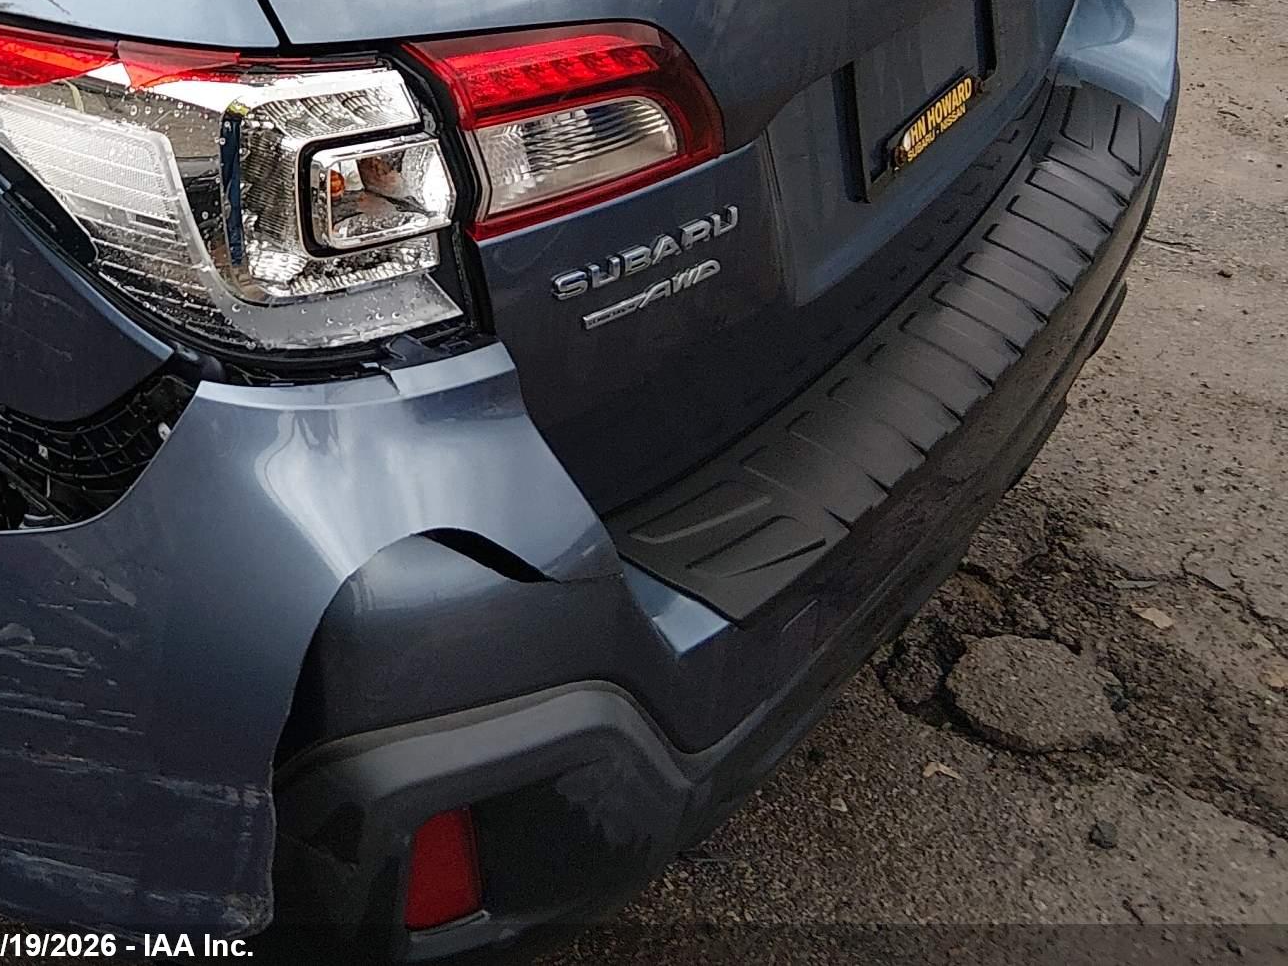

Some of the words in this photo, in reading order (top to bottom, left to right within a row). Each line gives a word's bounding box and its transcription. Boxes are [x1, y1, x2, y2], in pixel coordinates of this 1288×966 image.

[927, 77, 973, 131] HOWARD
[907, 129, 937, 162] SUBARU
[940, 103, 967, 133] NISSAN
[551, 205, 739, 301] SUBARU
[639, 259, 721, 309] AWD
